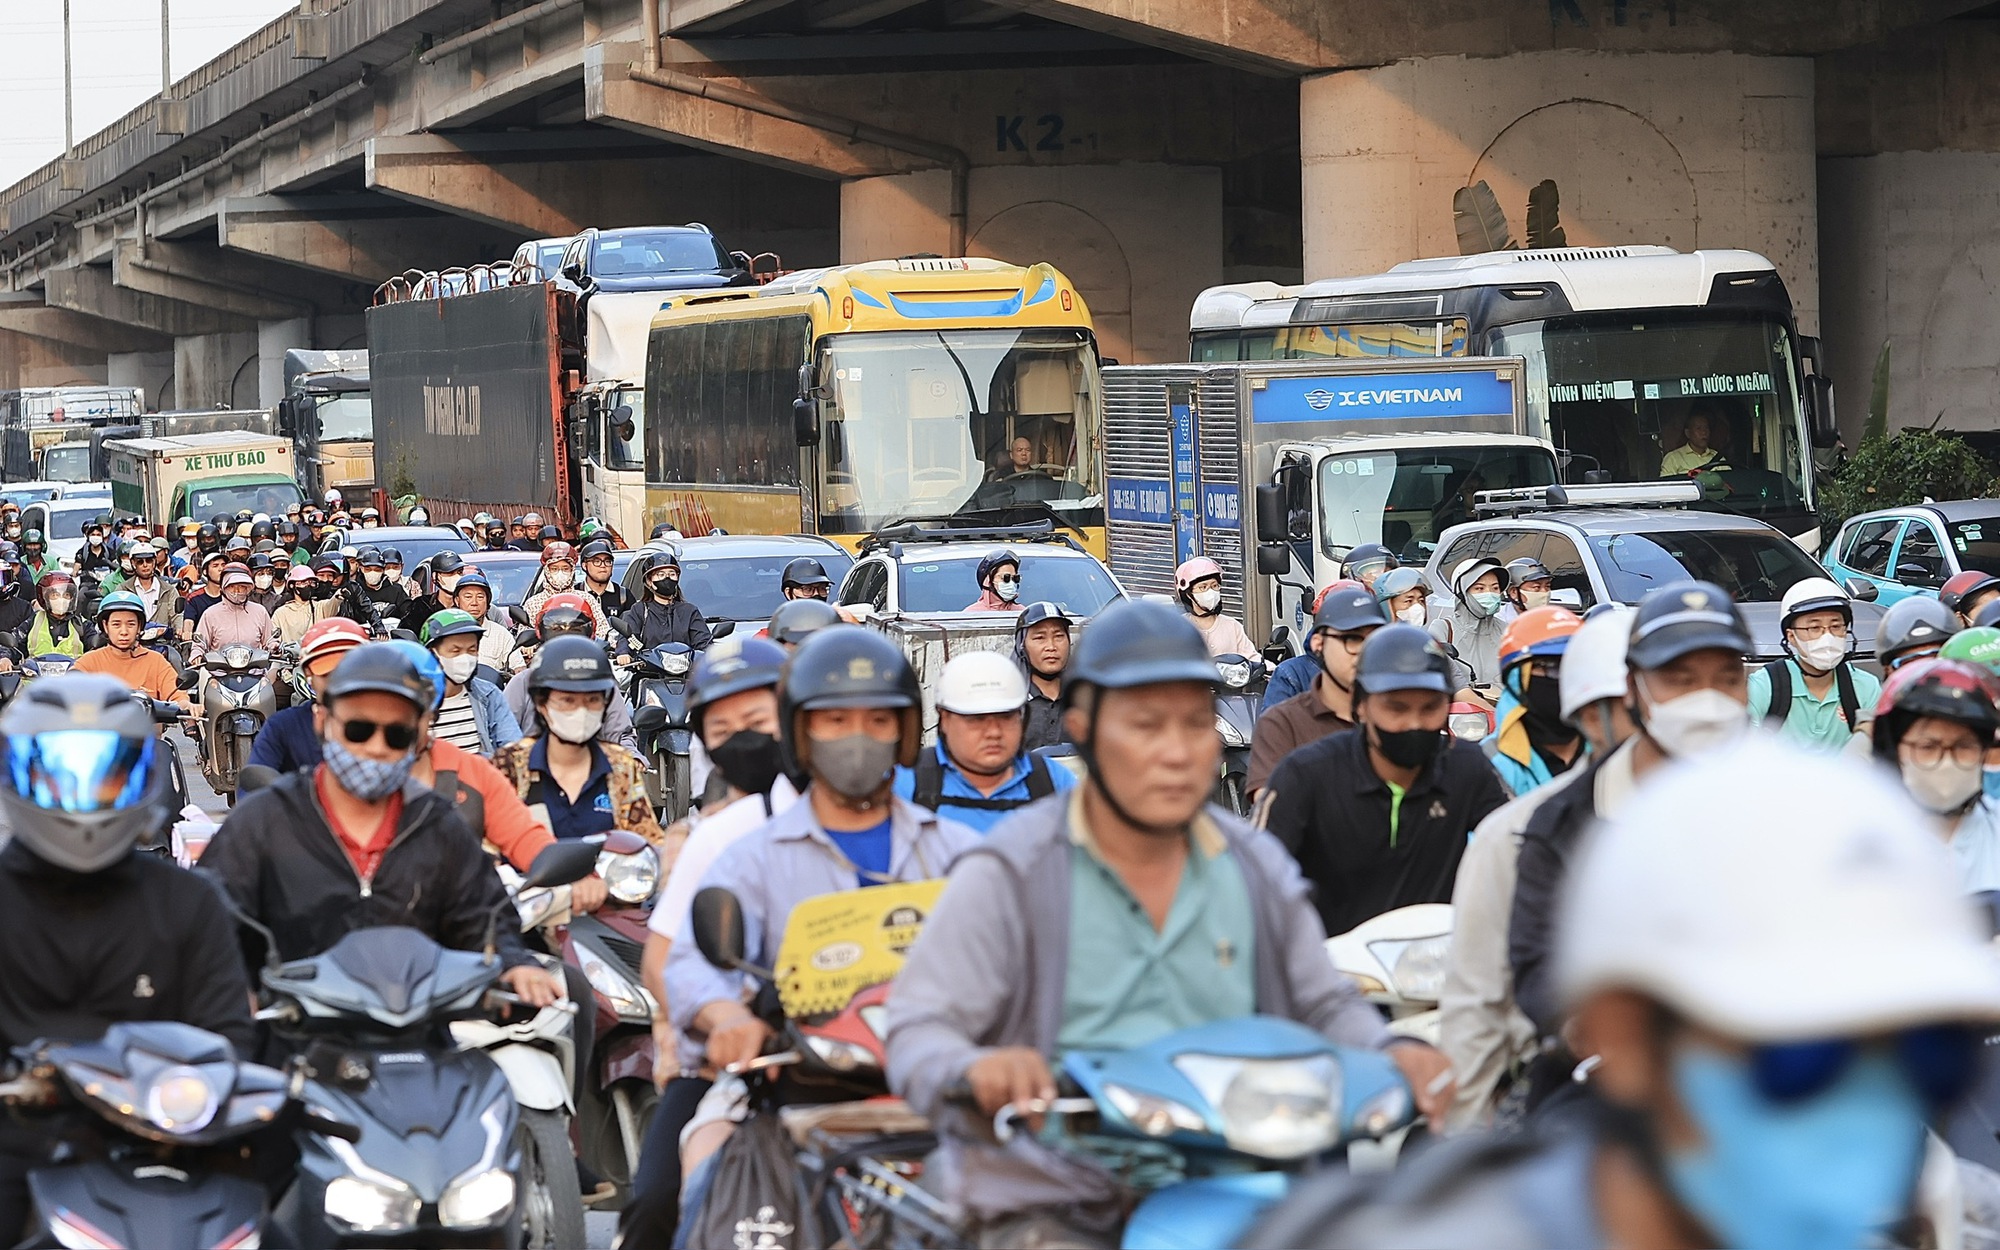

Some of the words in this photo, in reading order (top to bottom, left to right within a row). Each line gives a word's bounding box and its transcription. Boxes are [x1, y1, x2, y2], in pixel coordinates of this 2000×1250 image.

[1549, 383, 1579, 402] VĨNH
[1582, 381, 1614, 402] NIỆM
[1680, 378, 1699, 395] BX.
[185, 457, 202, 471] XE
[206, 452, 233, 469] THƯ
[237, 449, 266, 467] BÁO
